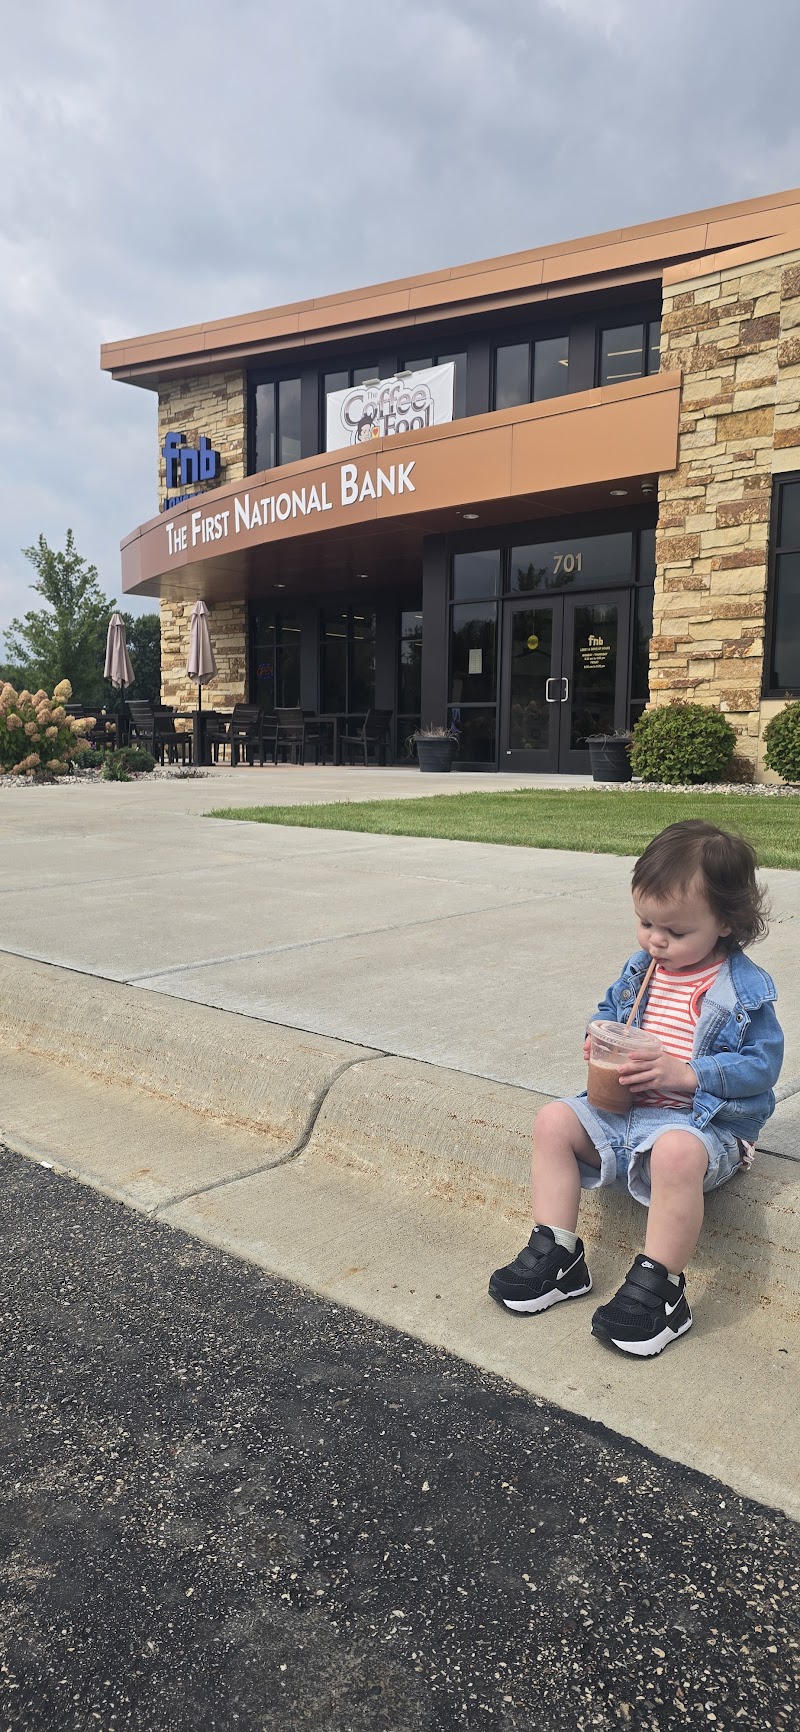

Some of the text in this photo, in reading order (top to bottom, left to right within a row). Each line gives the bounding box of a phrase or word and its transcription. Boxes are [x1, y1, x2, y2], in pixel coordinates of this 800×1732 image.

[344, 384, 428, 426] Coffee
[366, 391, 378, 400] The
[379, 402, 430, 436] Fool
[161, 431, 219, 489] fnb
[234, 482, 333, 534] NATIONAL
[340, 460, 416, 507] BANK
[553, 552, 583, 574] 701
[588, 634, 604, 647] fnb
